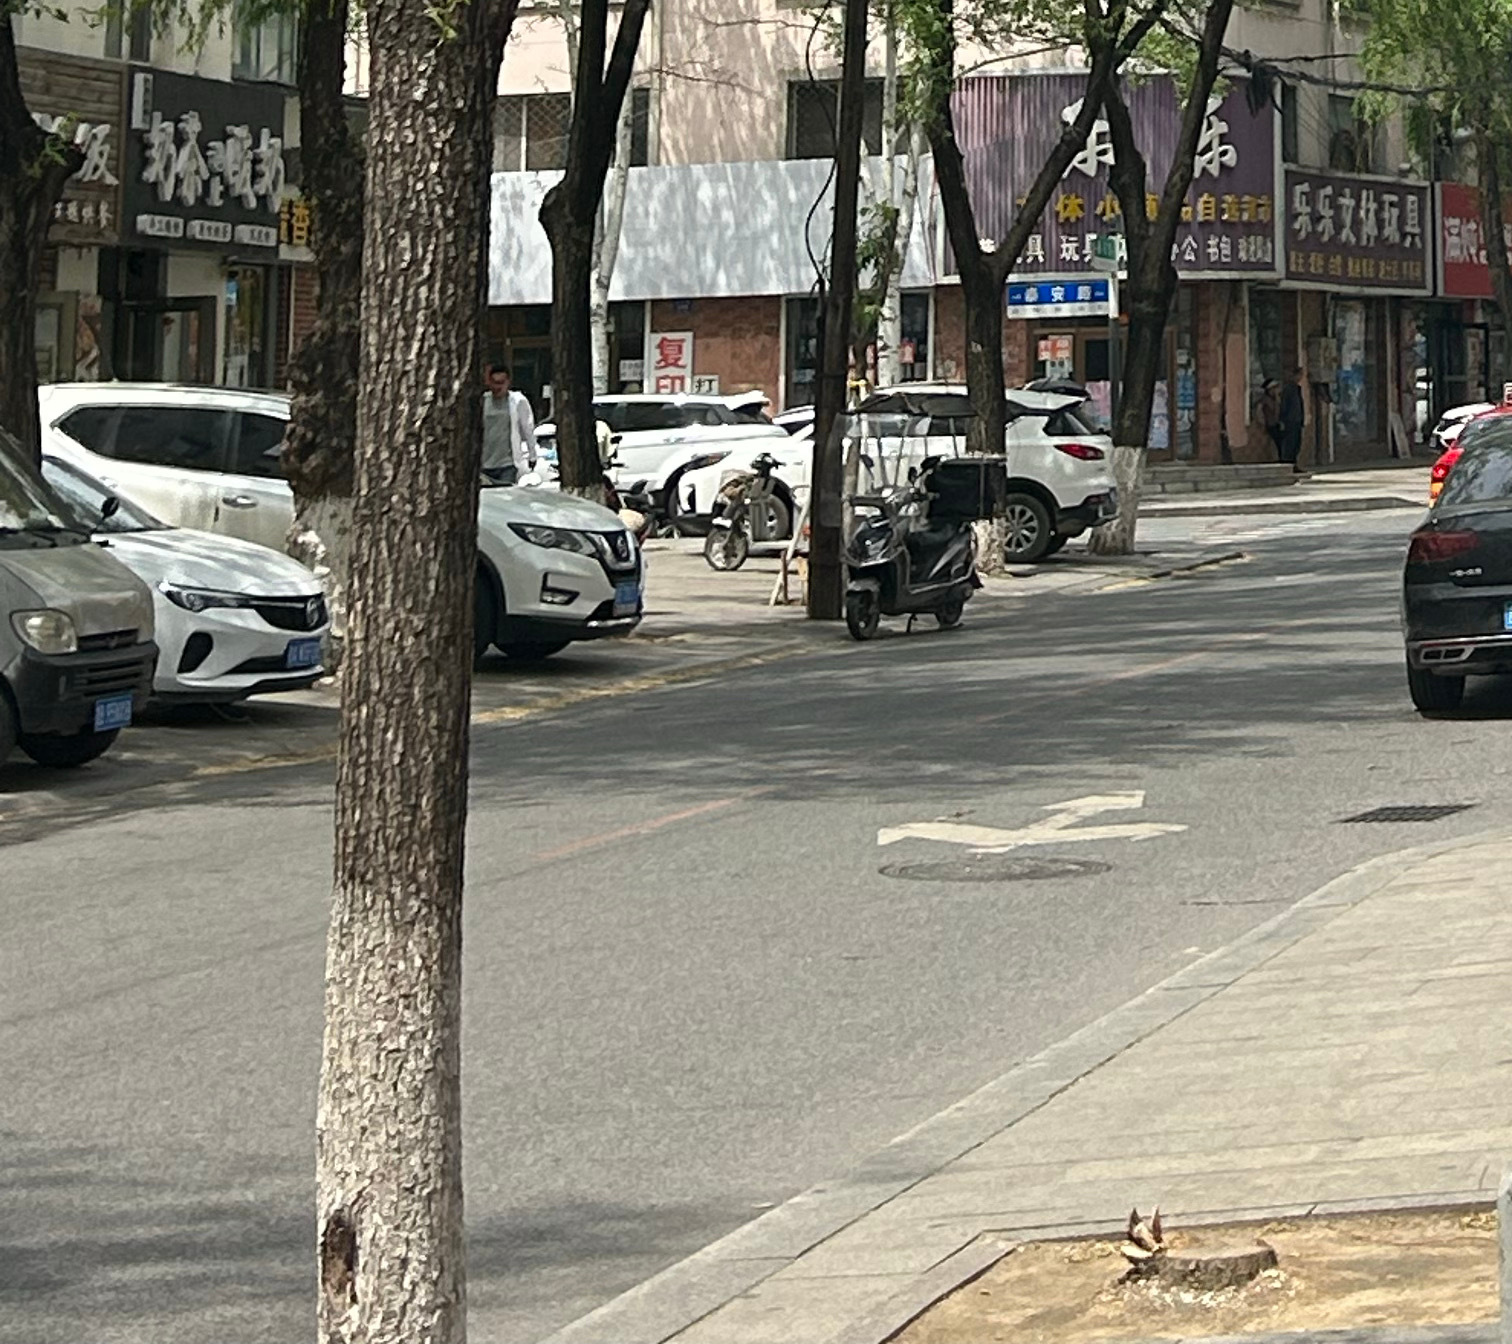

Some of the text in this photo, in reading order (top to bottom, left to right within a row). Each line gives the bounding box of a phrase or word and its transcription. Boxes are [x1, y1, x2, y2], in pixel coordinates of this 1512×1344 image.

[1293, 181, 1423, 250] 乐乐文体玩具
